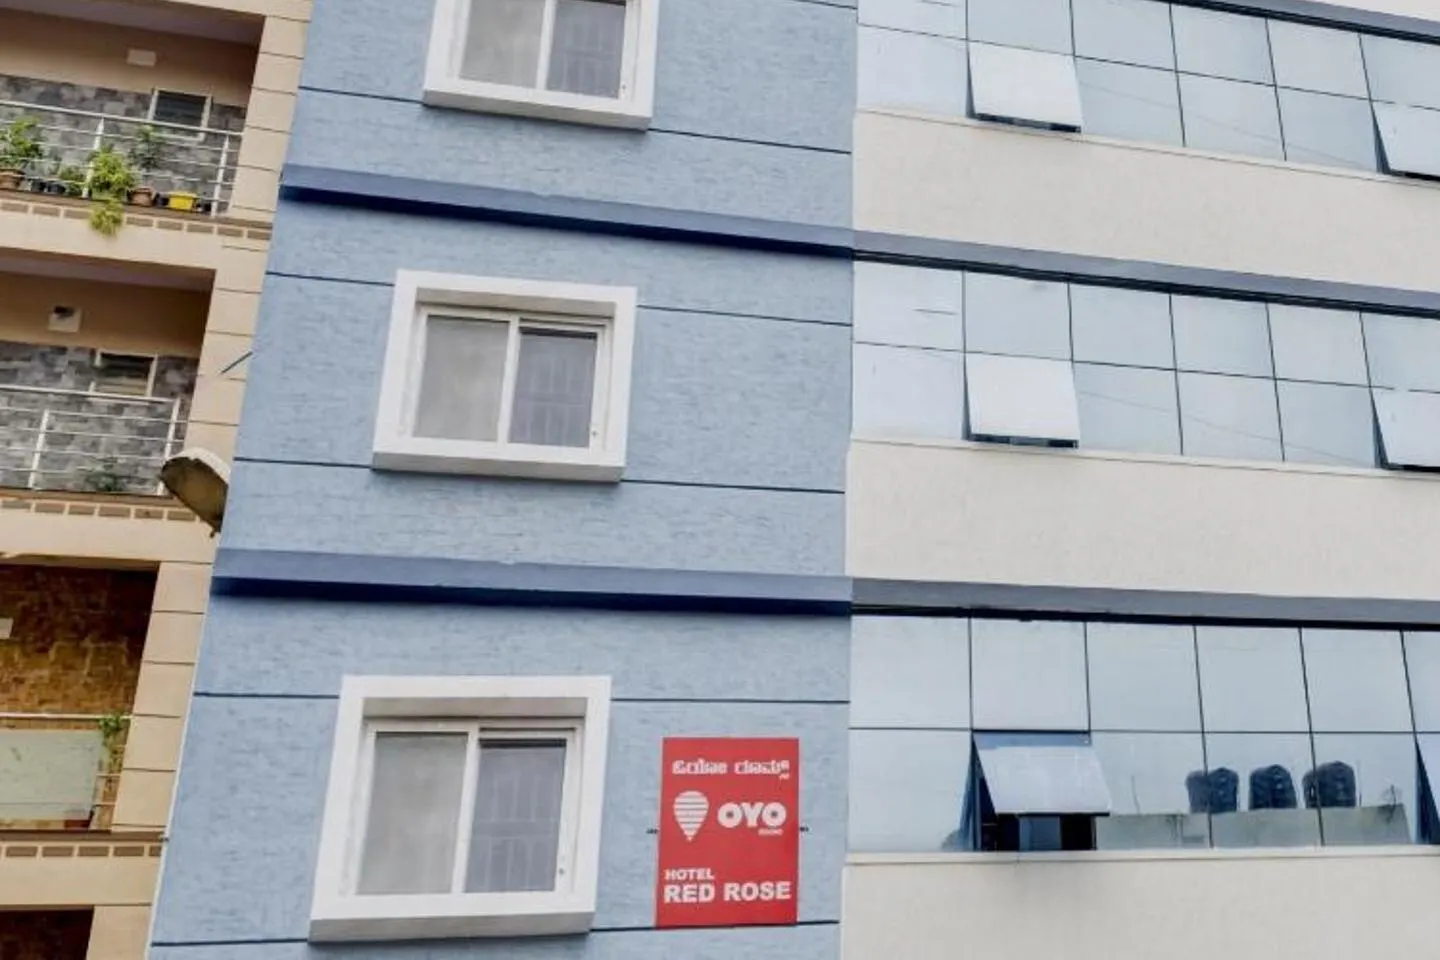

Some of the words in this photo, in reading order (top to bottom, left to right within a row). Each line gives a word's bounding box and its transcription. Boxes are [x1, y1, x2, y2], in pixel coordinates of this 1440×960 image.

[717, 802, 787, 828] OYO
[665, 868, 714, 880] HOTEL
[664, 884, 715, 903] RED
[723, 881, 792, 902] ROSE
